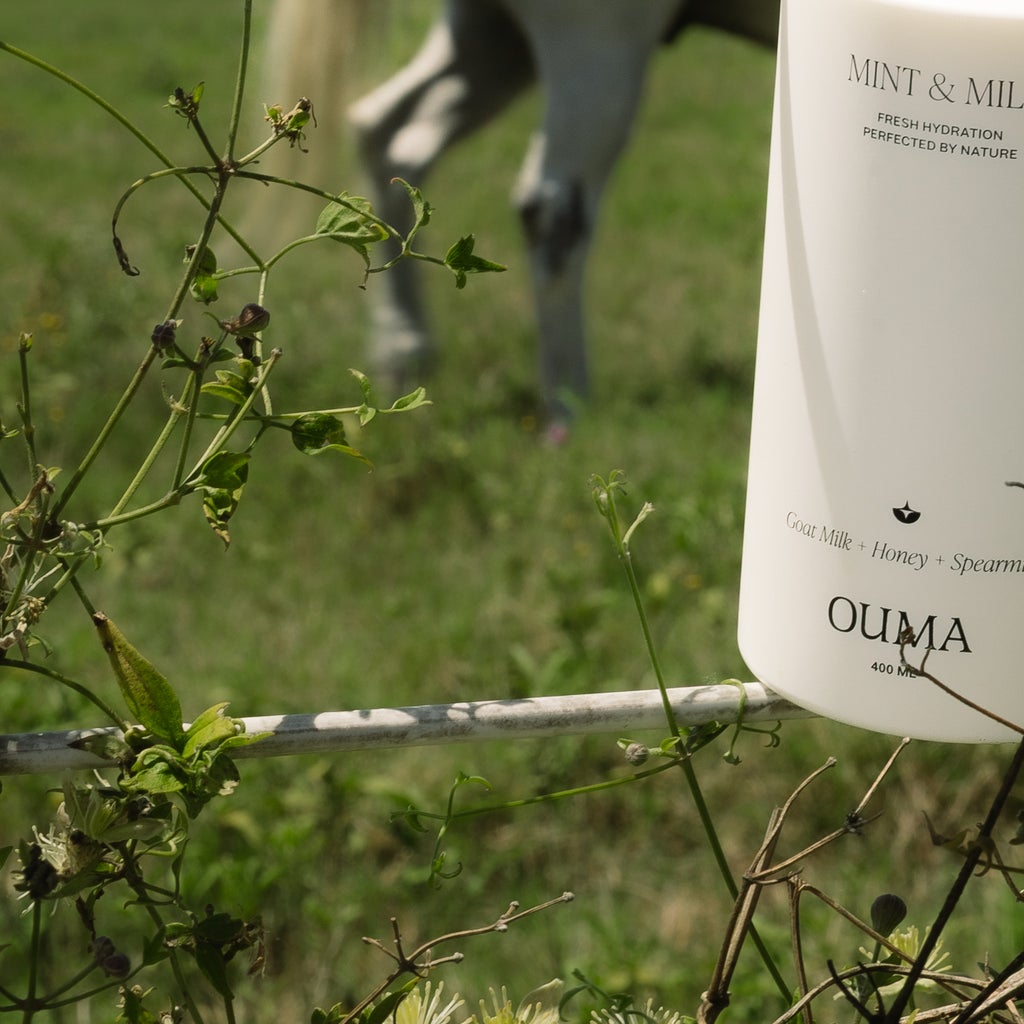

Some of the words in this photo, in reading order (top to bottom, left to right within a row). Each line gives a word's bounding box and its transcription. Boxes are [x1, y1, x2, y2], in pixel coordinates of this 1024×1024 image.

[848, 53, 921, 96] MINT
[928, 72, 956, 103] &
[863, 126, 937, 151] PERFECTED
[939, 142, 958, 154] BY
[960, 146, 1018, 160] NATURE
[877, 112, 919, 130] FRESH
[922, 121, 1004, 141] HYDRATION
[786, 511, 818, 539] Goat
[819, 526, 853, 551] Milk
[857, 540, 867, 552] +
[871, 541, 929, 571] Honey
[935, 554, 946, 566] +
[828, 596, 973, 653] OUMA
[870, 661, 894, 676] 400
